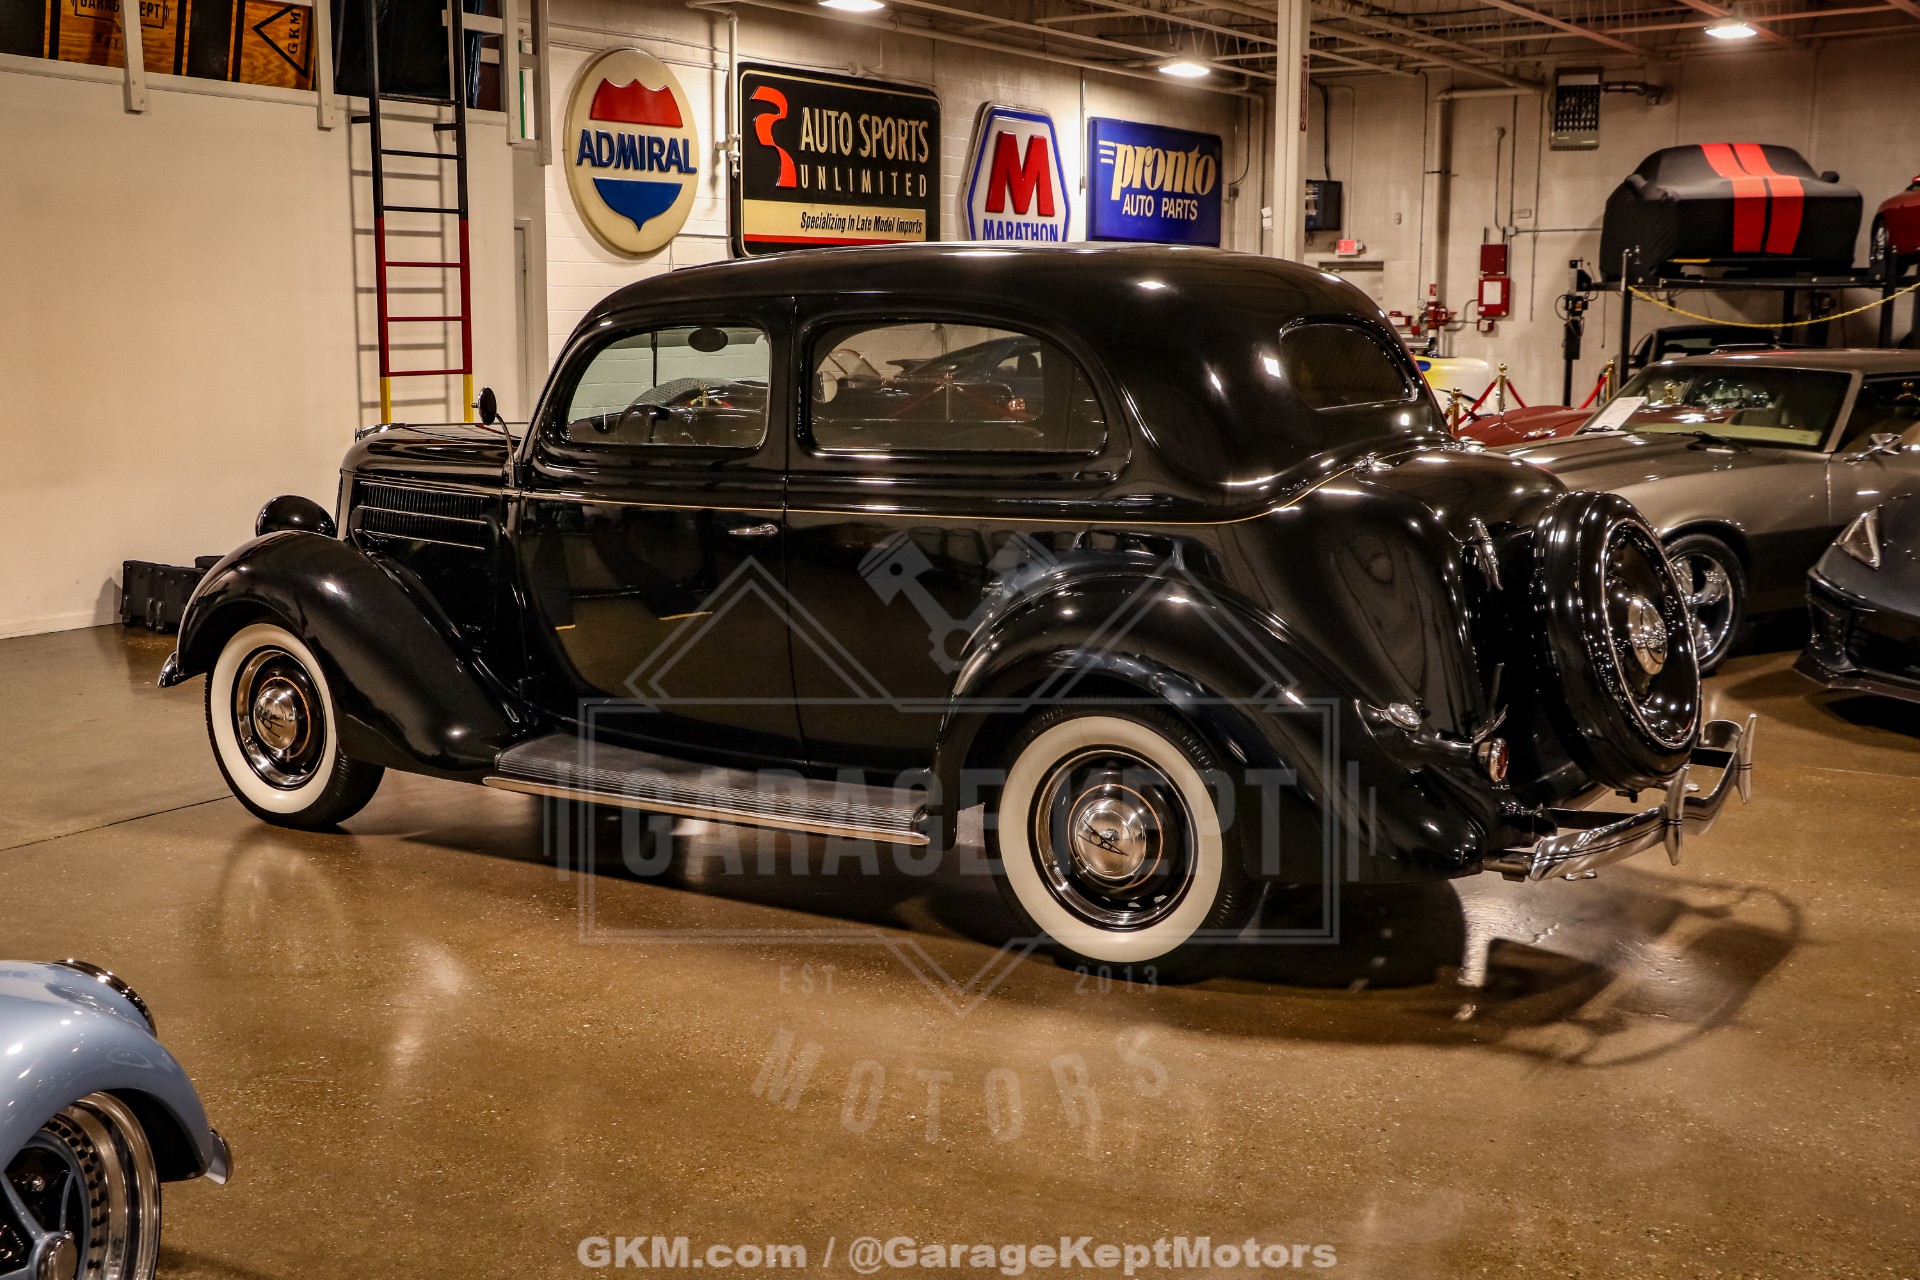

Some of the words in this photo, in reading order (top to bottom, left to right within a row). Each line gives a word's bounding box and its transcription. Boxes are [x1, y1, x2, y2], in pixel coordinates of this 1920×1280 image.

[140, 2, 161, 18] EPT
[287, 11, 301, 55] GKM
[576, 127, 697, 174] ADMIRAL
[800, 106, 853, 156] AUTO
[858, 113, 930, 164] SPORTS
[800, 164, 927, 198] UNLIMITED
[985, 131, 1056, 217] M
[1110, 143, 1216, 201] pronto
[800, 211, 846, 233] Specializing
[847, 215, 855, 231] In
[856, 215, 872, 232] Late
[873, 216, 895, 233] Model
[896, 217, 922, 236] Imports
[1122, 193, 1155, 218] AUTO
[1161, 197, 1198, 221] PARTS
[982, 218, 1058, 242] MARATHON
